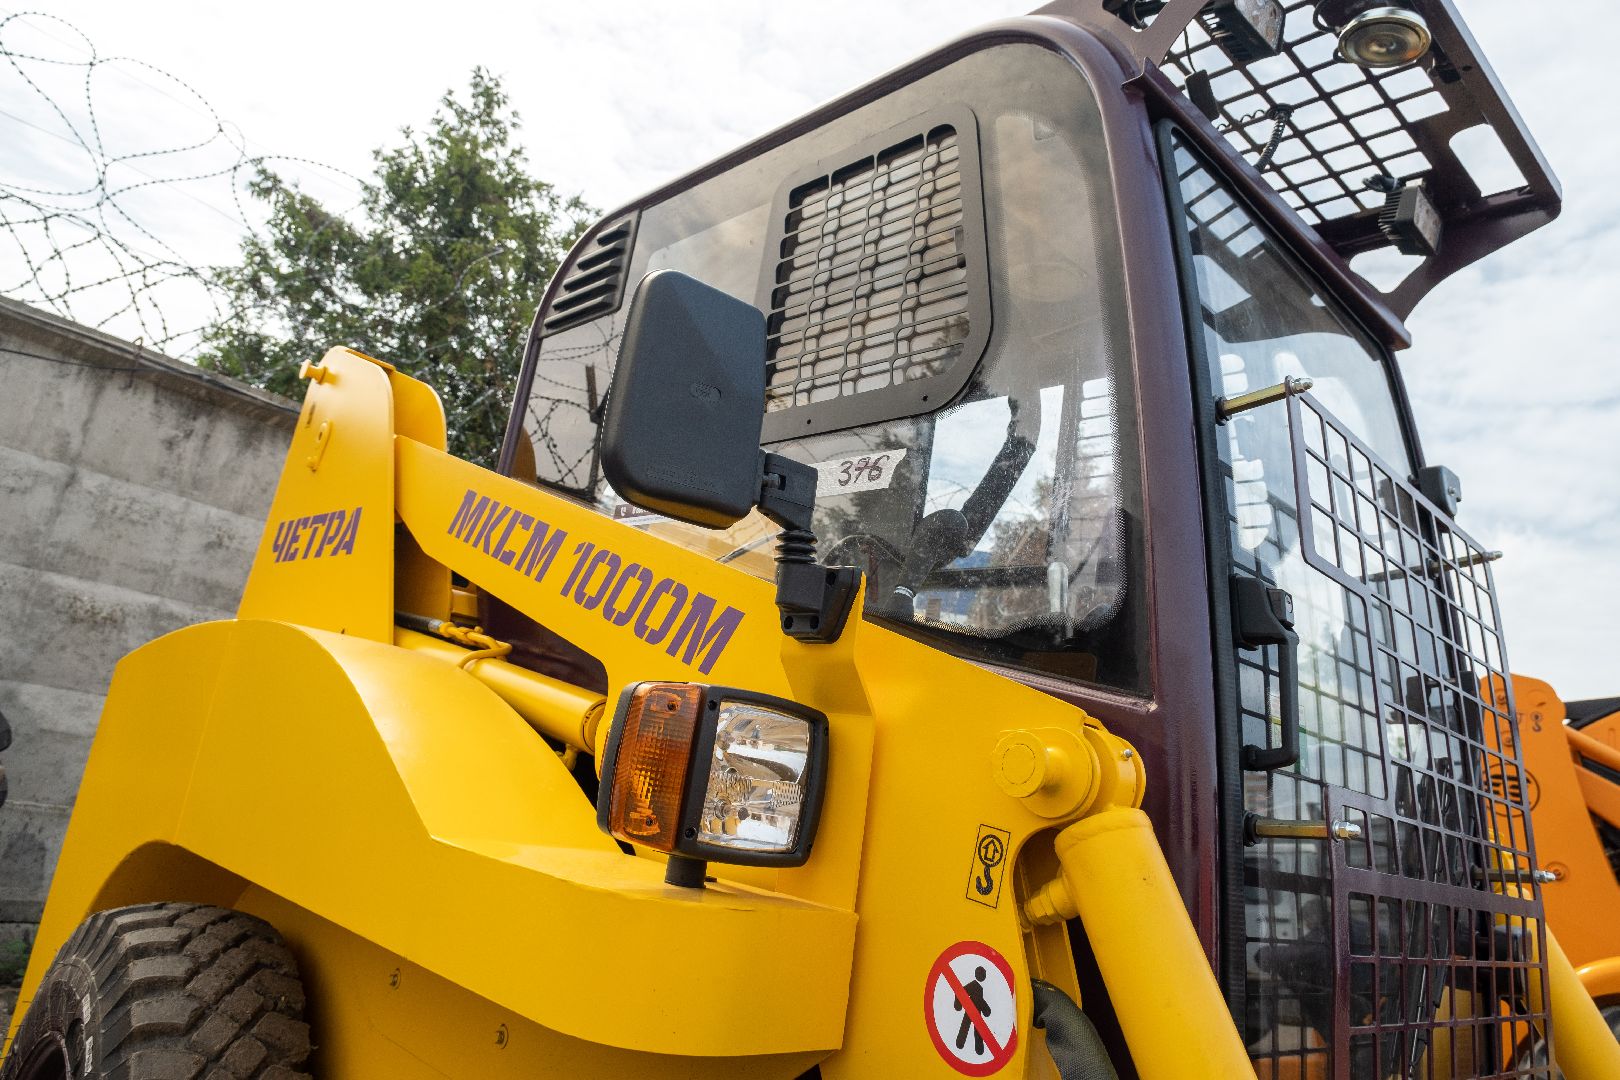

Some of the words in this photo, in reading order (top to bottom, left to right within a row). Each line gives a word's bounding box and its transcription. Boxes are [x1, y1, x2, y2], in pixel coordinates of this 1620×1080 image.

[272, 506, 363, 563] ЧЕТРА
[447, 489, 568, 583] МКСМ
[560, 541, 746, 676] 1000М
